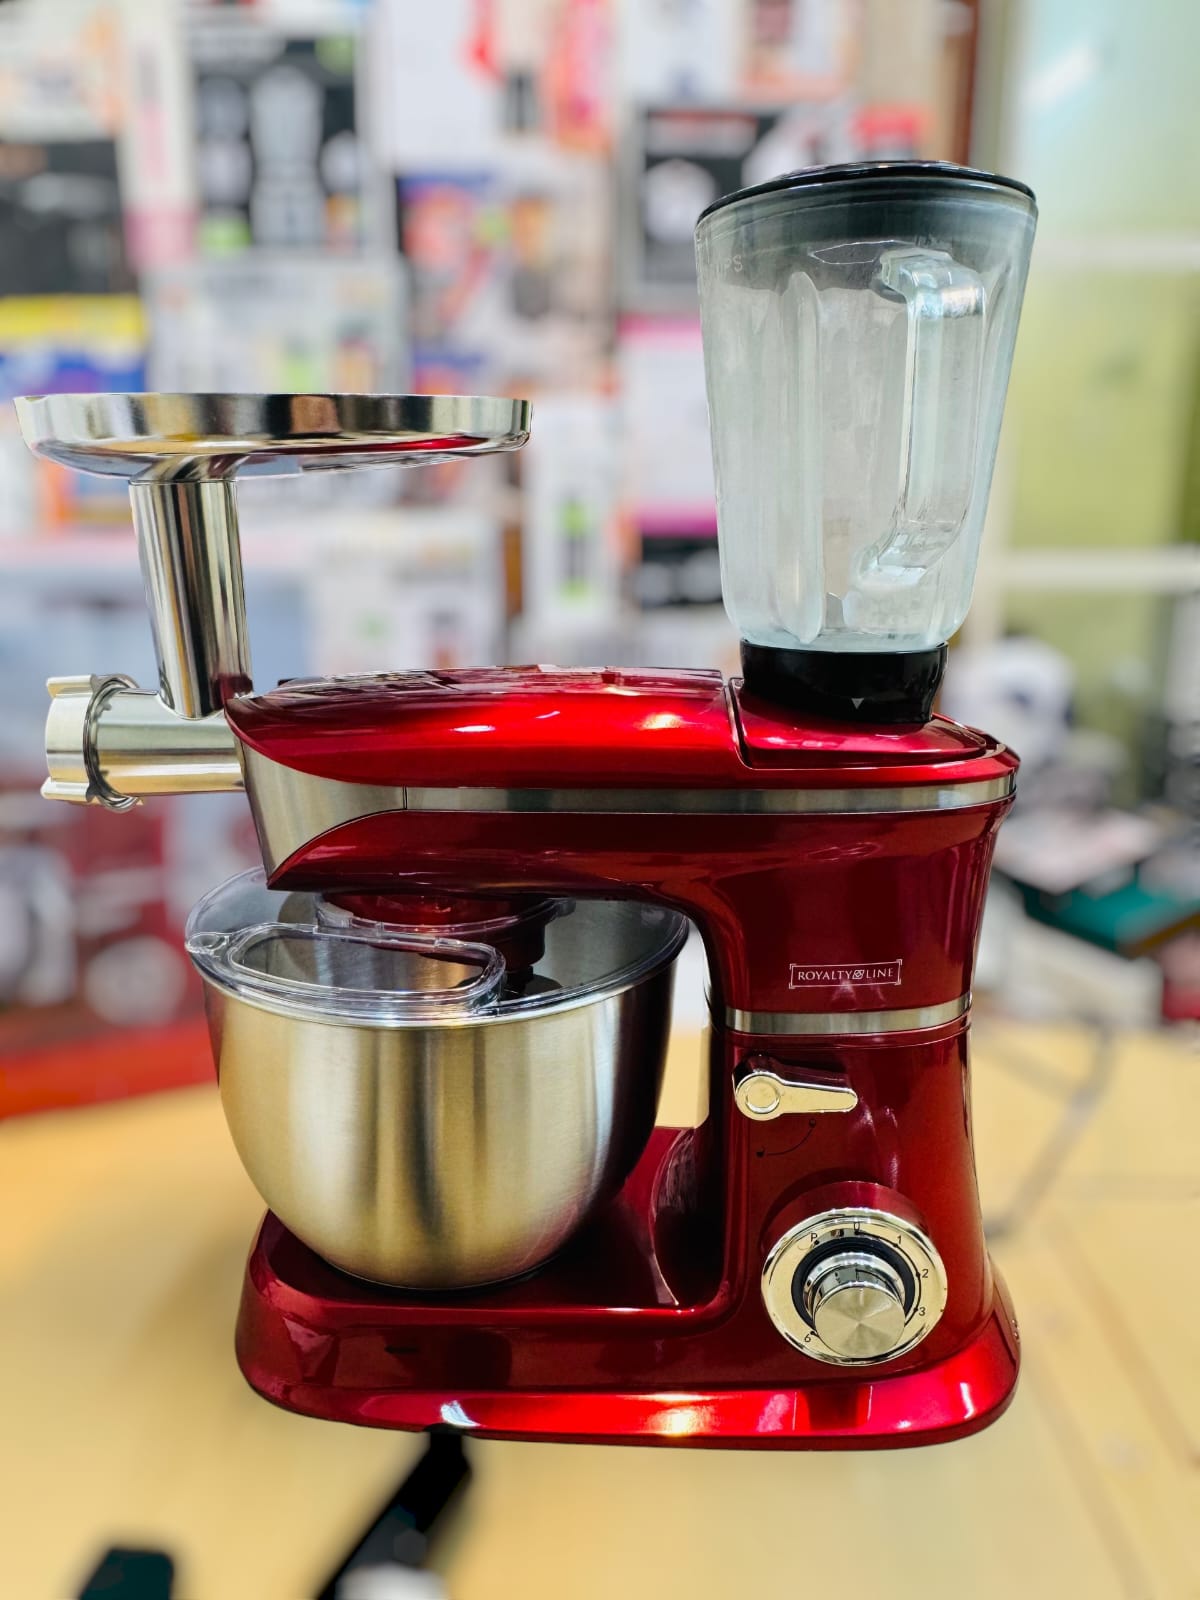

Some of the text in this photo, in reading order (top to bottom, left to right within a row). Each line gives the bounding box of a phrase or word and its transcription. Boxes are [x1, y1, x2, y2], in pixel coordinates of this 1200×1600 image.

[797, 967, 894, 981] ROYALTY LINE
[810, 1232, 818, 1242] P
[921, 1268, 929, 1279] 2
[918, 1306, 926, 1317] 3
[804, 1333, 811, 1342] 6
